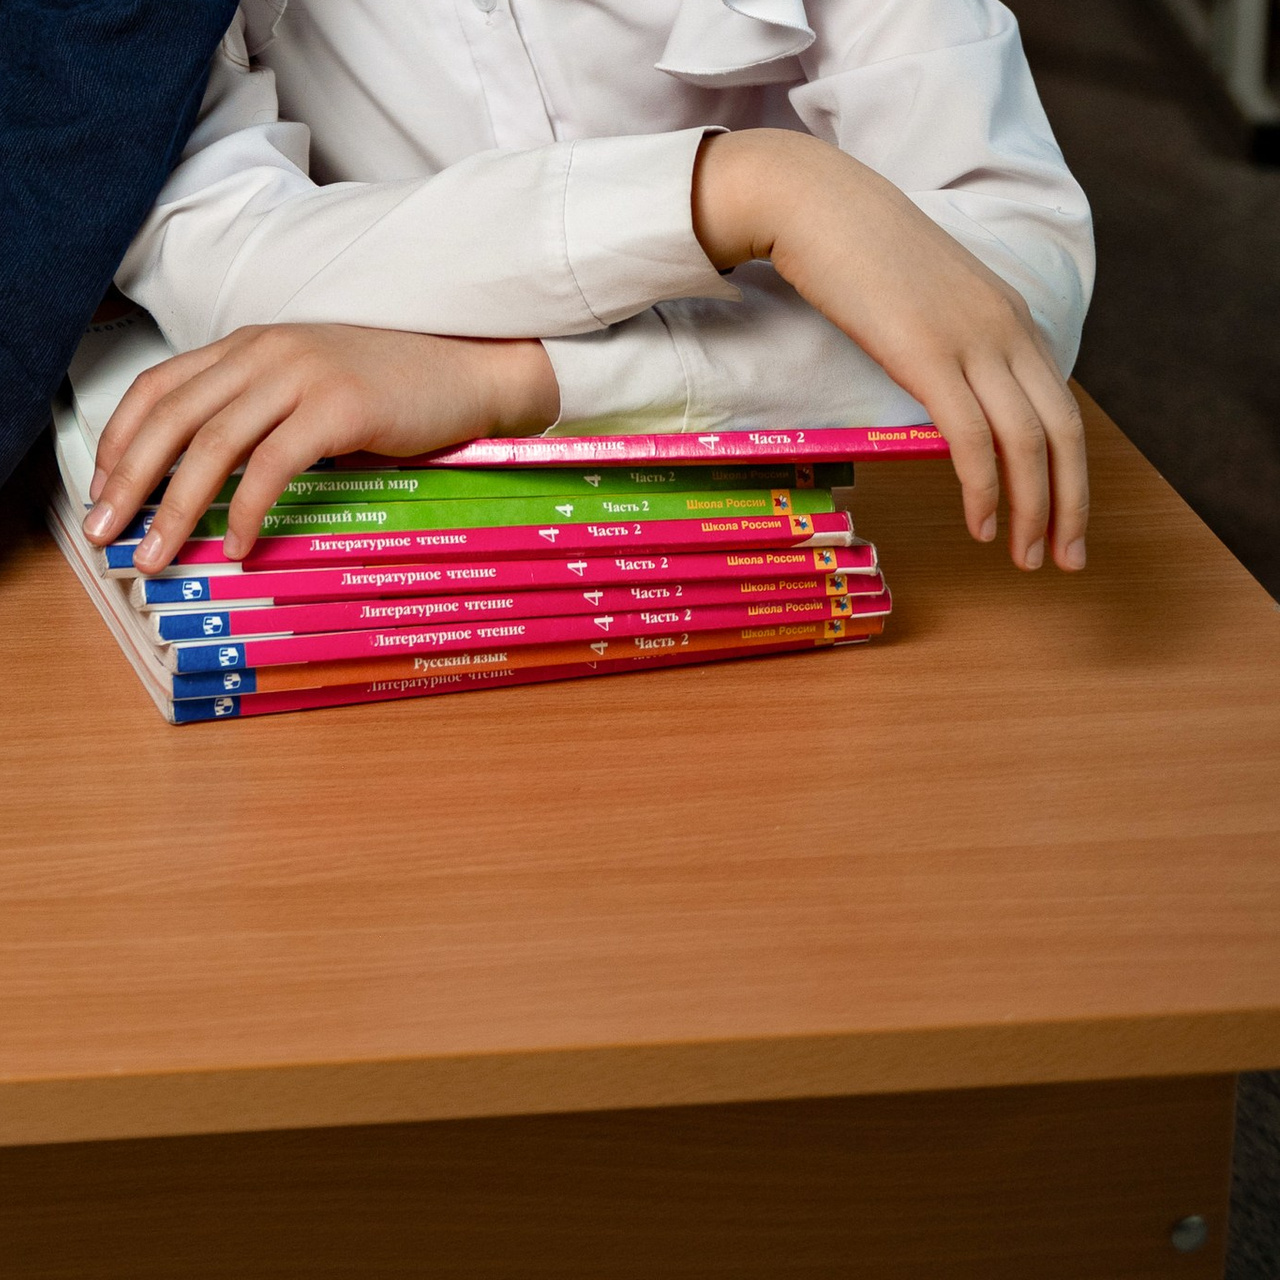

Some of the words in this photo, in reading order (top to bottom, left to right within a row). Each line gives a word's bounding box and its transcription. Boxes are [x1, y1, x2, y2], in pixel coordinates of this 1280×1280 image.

[698, 434, 719, 449] 4
[749, 433, 791, 444] Часть
[797, 432, 805, 443] 2
[868, 431, 907, 441] Школа
[910, 430, 942, 440] Росс
[573, 441, 625, 451] чтение
[584, 474, 601, 487] 4
[630, 472, 665, 484] Часть
[668, 472, 676, 482] 2
[284, 478, 384, 495] кружающий
[388, 479, 418, 492] мир
[555, 504, 573, 517] 4
[603, 502, 639, 513] Часть
[642, 501, 649, 511] 2
[686, 499, 723, 510] Школа
[726, 498, 766, 508] России
[262, 510, 352, 528] ружающий
[356, 510, 387, 524] мир
[701, 522, 738, 532] Школа
[741, 519, 781, 530] России
[539, 527, 559, 543] 4
[587, 525, 628, 537] Часть
[633, 523, 641, 534] 2
[310, 536, 411, 552] Литературное
[416, 533, 467, 545] чтение
[615, 558, 655, 570] Часть
[660, 557, 668, 568] 2
[726, 556, 763, 566] Школа
[766, 553, 805, 563] России
[567, 560, 587, 576] 4
[341, 569, 441, 587] Литературное
[446, 566, 496, 579] чтение
[630, 587, 670, 599] Часть
[675, 585, 682, 596] 2
[741, 582, 776, 592] Школа
[779, 579, 817, 590] России
[583, 590, 603, 606] 4
[360, 601, 459, 618] Литературное
[464, 597, 513, 611] чтение
[748, 605, 782, 616] Школа
[785, 601, 823, 612] России
[594, 615, 614, 631] 4
[640, 611, 679, 624] Часть
[684, 608, 692, 621] 2
[374, 628, 471, 647] Литературное
[476, 624, 526, 638] чтение
[741, 628, 775, 639] Школа
[778, 624, 816, 636] России
[590, 640, 608, 655] 4
[634, 637, 675, 649] Часть
[681, 633, 689, 645] 2
[414, 654, 470, 671] Русский
[473, 652, 507, 664] язык
